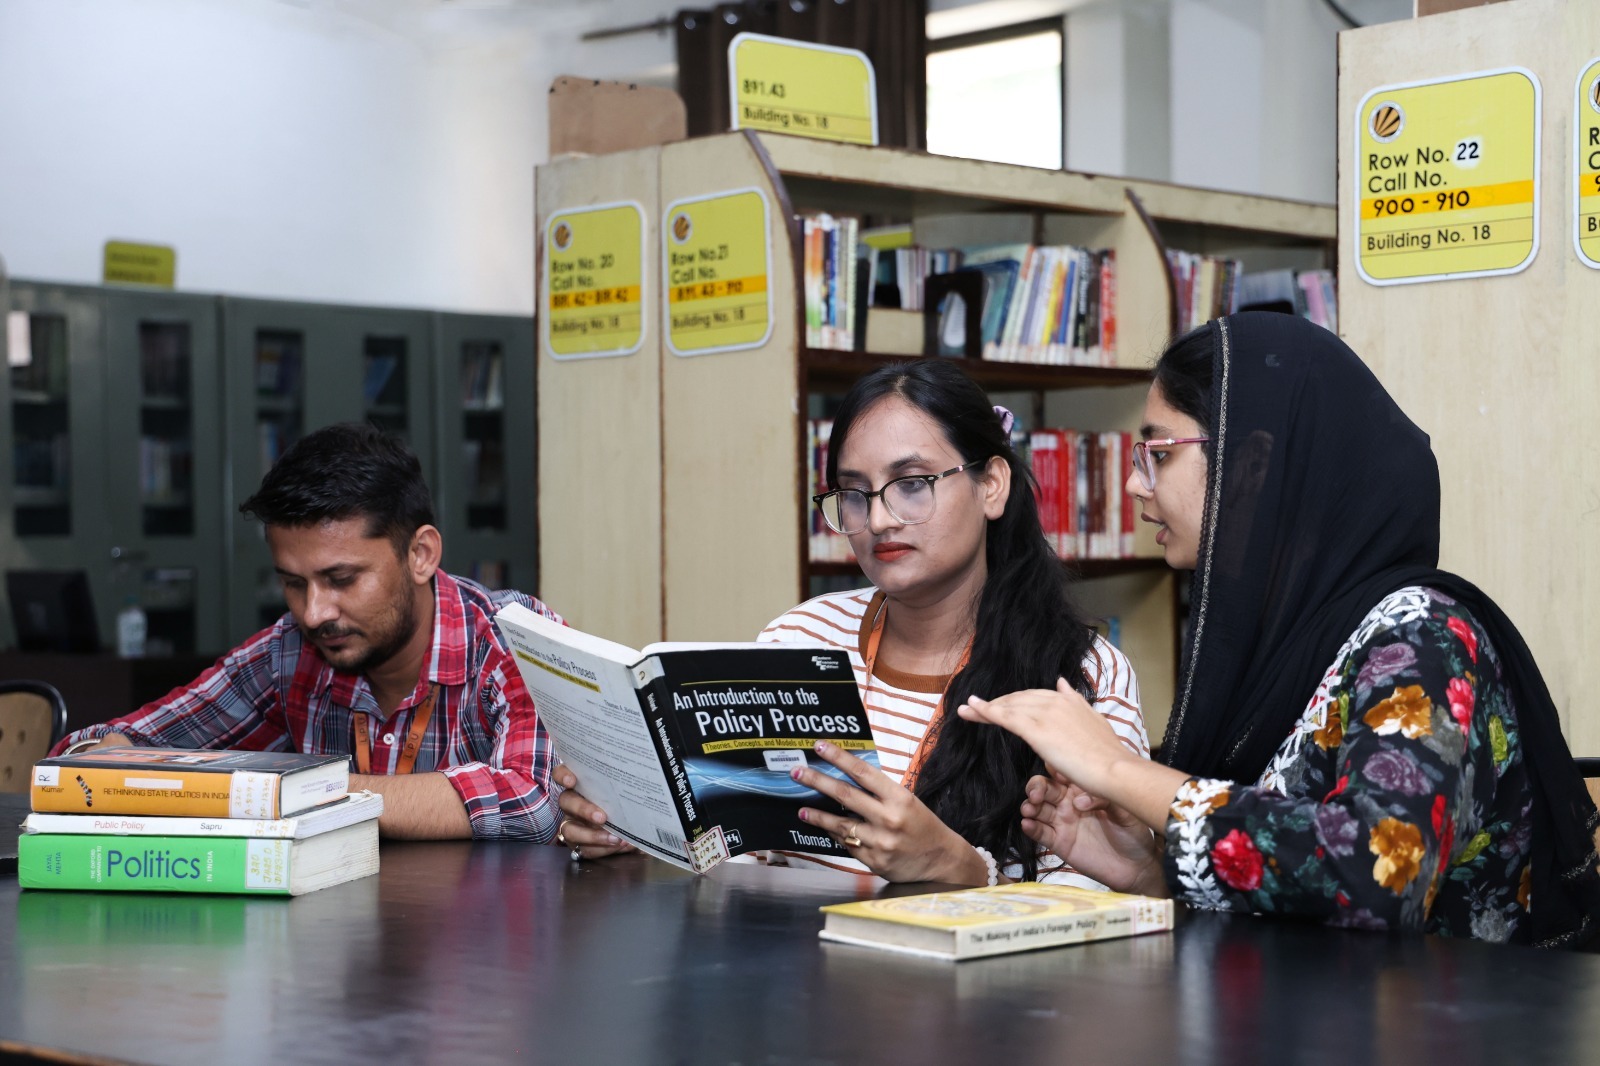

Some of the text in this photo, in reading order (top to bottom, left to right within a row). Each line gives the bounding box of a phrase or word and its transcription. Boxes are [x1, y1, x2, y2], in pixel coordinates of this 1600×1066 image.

[743, 79, 786, 99] 891.43
[744, 106, 829, 129] Building No. 18
[1368, 141, 1480, 170] Row No. 22
[1368, 170, 1447, 193] Call No.
[1373, 198, 1415, 217] 900
[1436, 190, 1470, 210] 910
[1367, 224, 1491, 251] Building No. 18
[552, 259, 574, 273] Row
[577, 257, 596, 271] No.
[671, 252, 695, 266] Row
[552, 275, 594, 290] Call No.
[671, 267, 717, 284] Call No.
[552, 320, 589, 335] Building
[590, 318, 605, 330] No.
[672, 306, 745, 329] Building No. 18
[517, 641, 540, 658] Introduction
[552, 653, 571, 673] Policy
[570, 661, 597, 681] Process
[672, 687, 820, 711] An Introduction to the
[695, 708, 860, 737] Policy Process
[404, 733, 419, 760] LPU
[705, 741, 732, 751] Theories,
[733, 740, 763, 749] Concepts,
[764, 739, 775, 747] and
[776, 739, 798, 747] Models
[798, 739, 805, 747] of
[844, 740, 865, 749] Making
[655, 717, 697, 821] An Introduction to the Policy Process
[103, 788, 230, 800] RETHINKING STATE POLITICS IN INDIA
[94, 821, 145, 831] Public Policy
[200, 822, 222, 832] Sapru
[789, 830, 832, 848] Thomas
[107, 849, 200, 880] Politics
[207, 874, 213, 882] IN
[970, 934, 983, 942] The
[986, 931, 1010, 940] Making
[1013, 929, 1020, 937] of
[1047, 922, 1072, 933] Foreign
[1076, 919, 1097, 929] Policy
